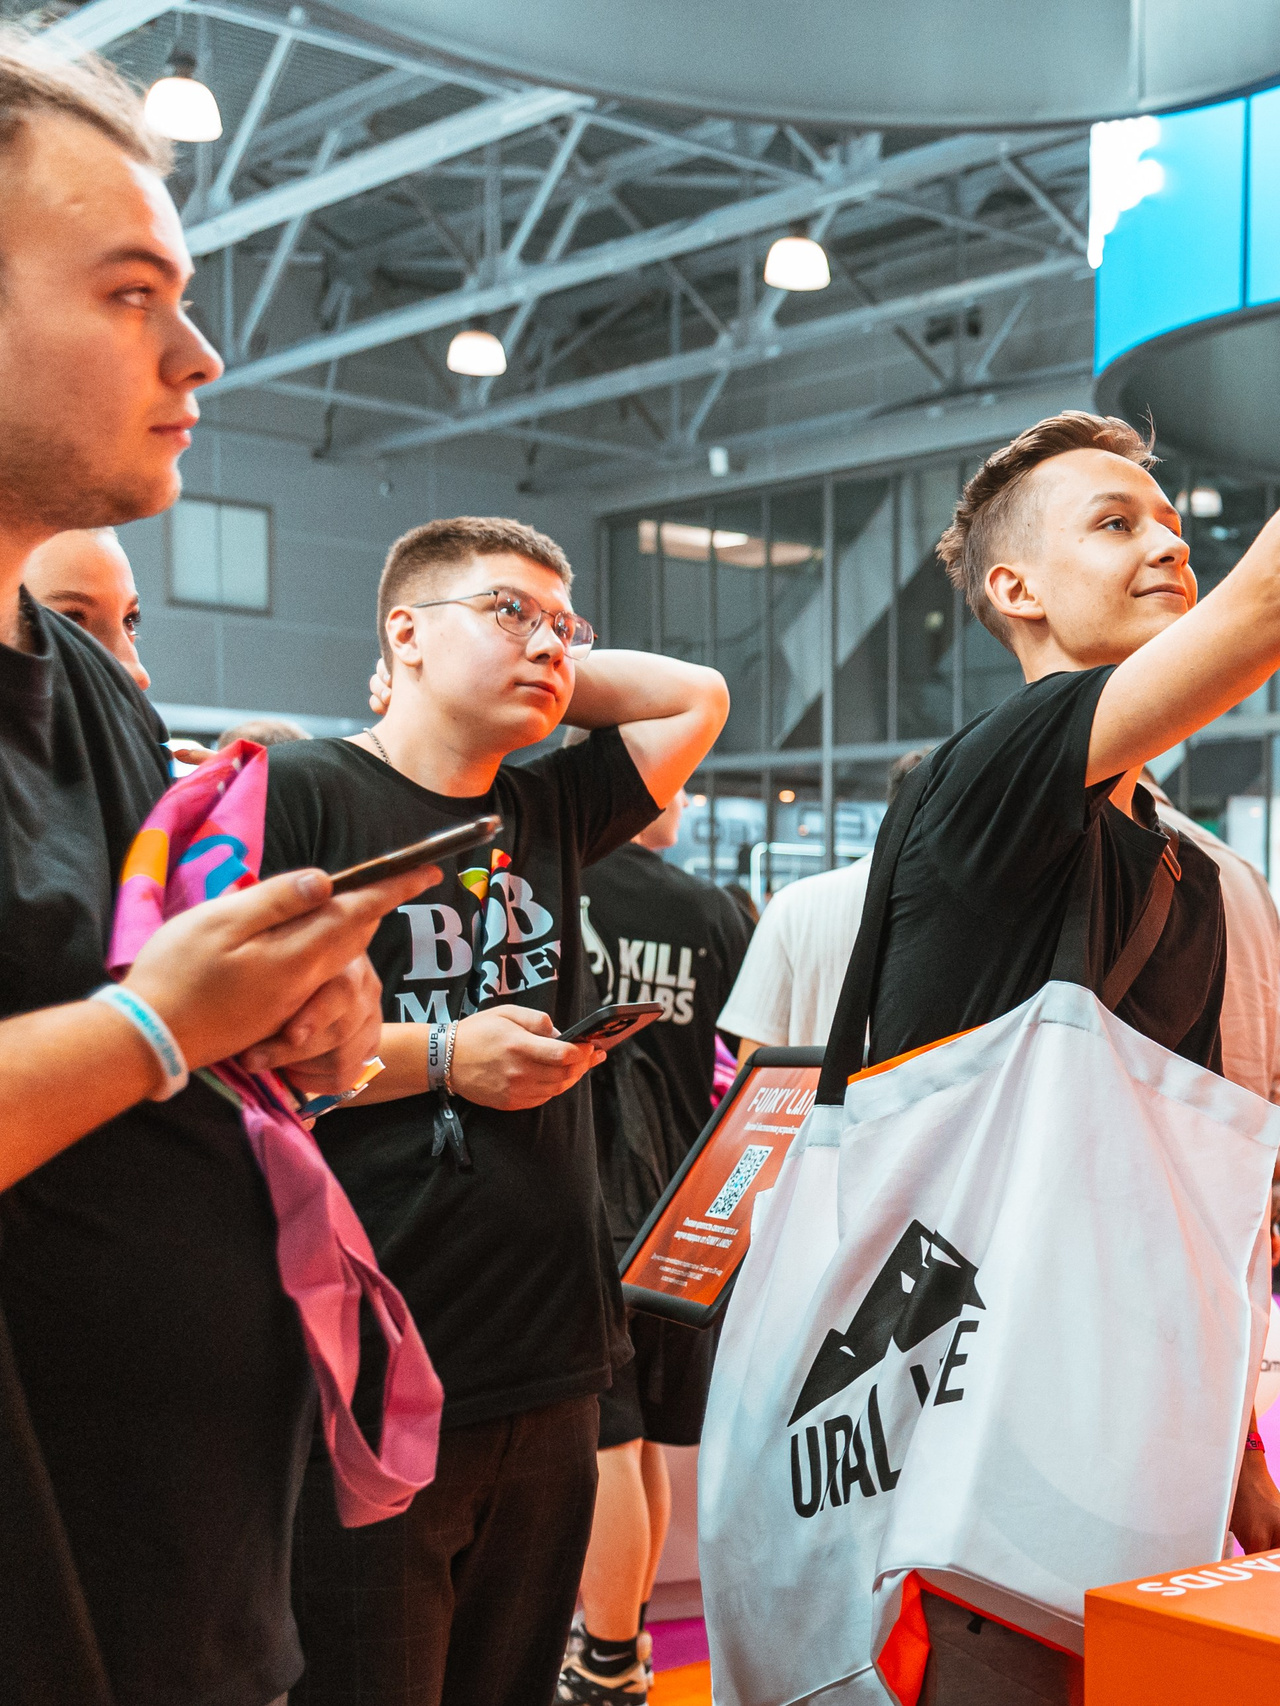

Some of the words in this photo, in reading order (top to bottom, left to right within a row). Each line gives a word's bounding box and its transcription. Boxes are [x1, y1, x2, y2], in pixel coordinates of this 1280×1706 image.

[397, 872, 554, 981] BOB
[618, 937, 696, 990] KILL
[430, 1032, 439, 1066] CLUB
[747, 1087, 794, 1114] FUNKY
